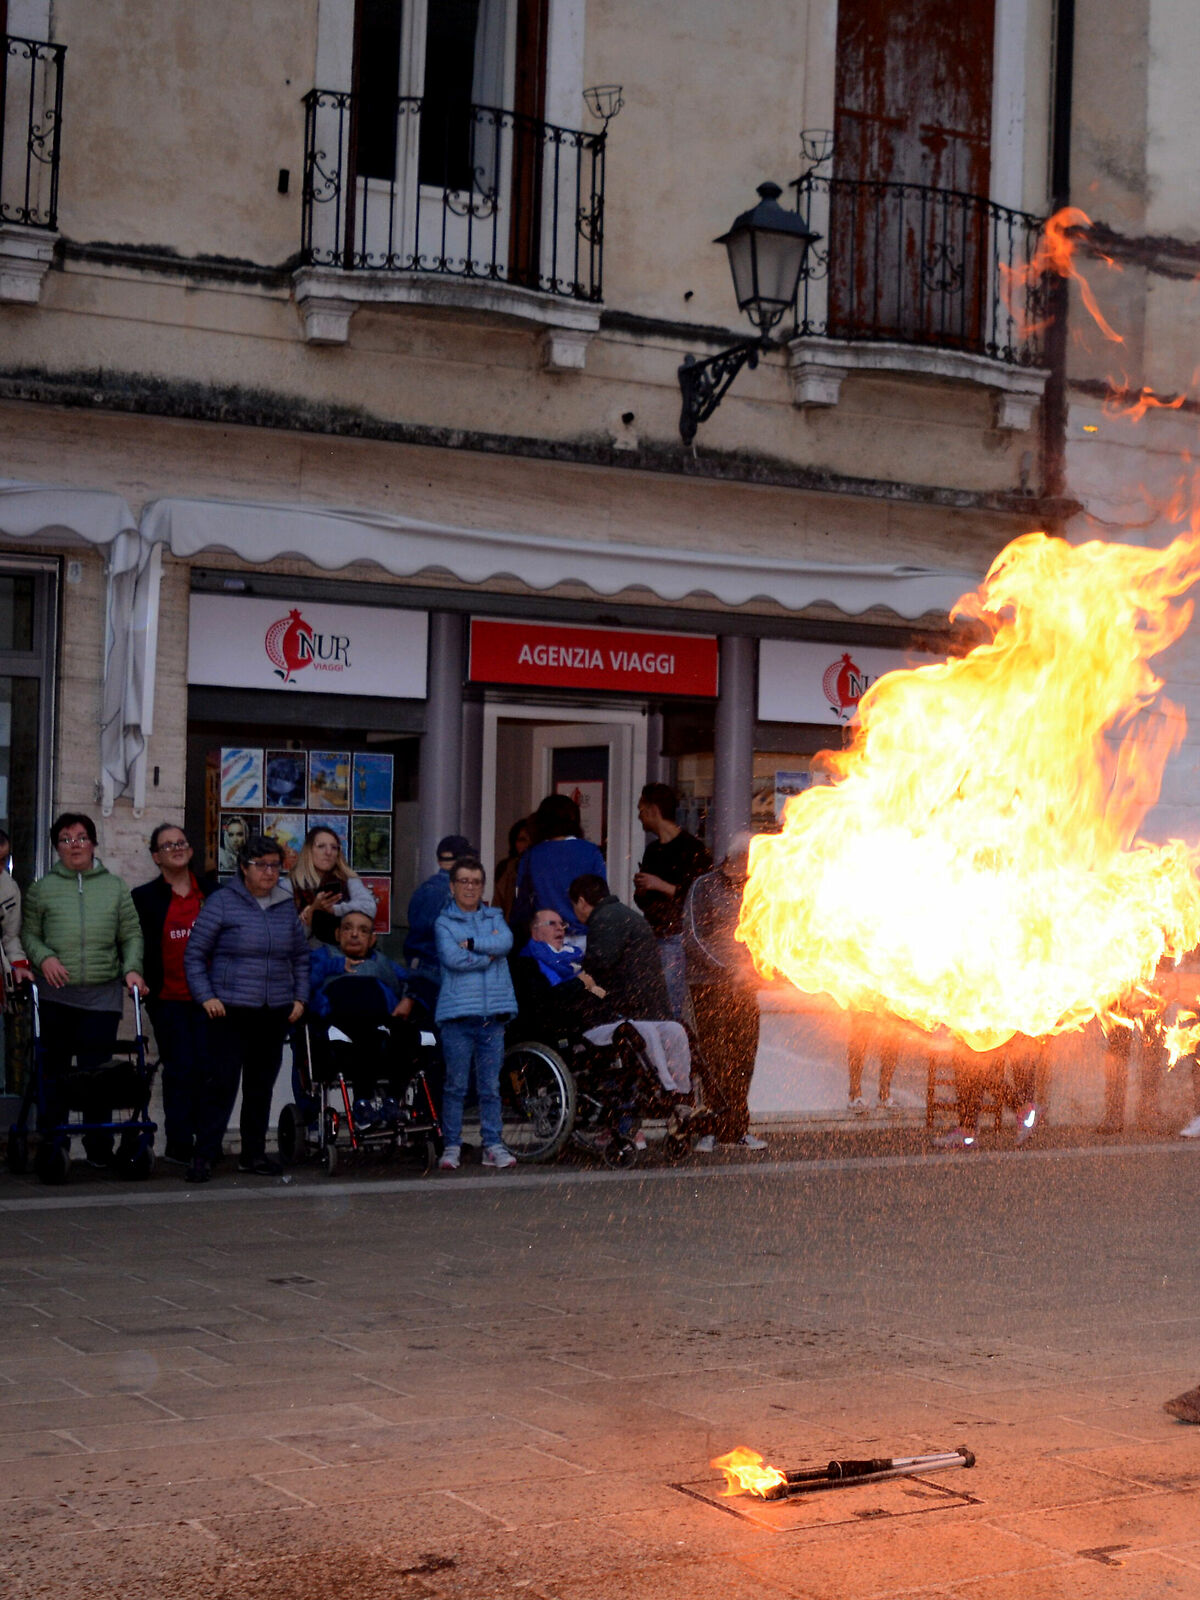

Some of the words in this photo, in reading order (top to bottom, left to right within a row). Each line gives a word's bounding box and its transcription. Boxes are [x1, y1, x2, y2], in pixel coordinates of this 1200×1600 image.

[298, 630, 351, 668] NUR
[517, 643, 604, 671] AGENZIA
[608, 650, 675, 675] VIAGGI
[313, 662, 344, 673] VIAGGI
